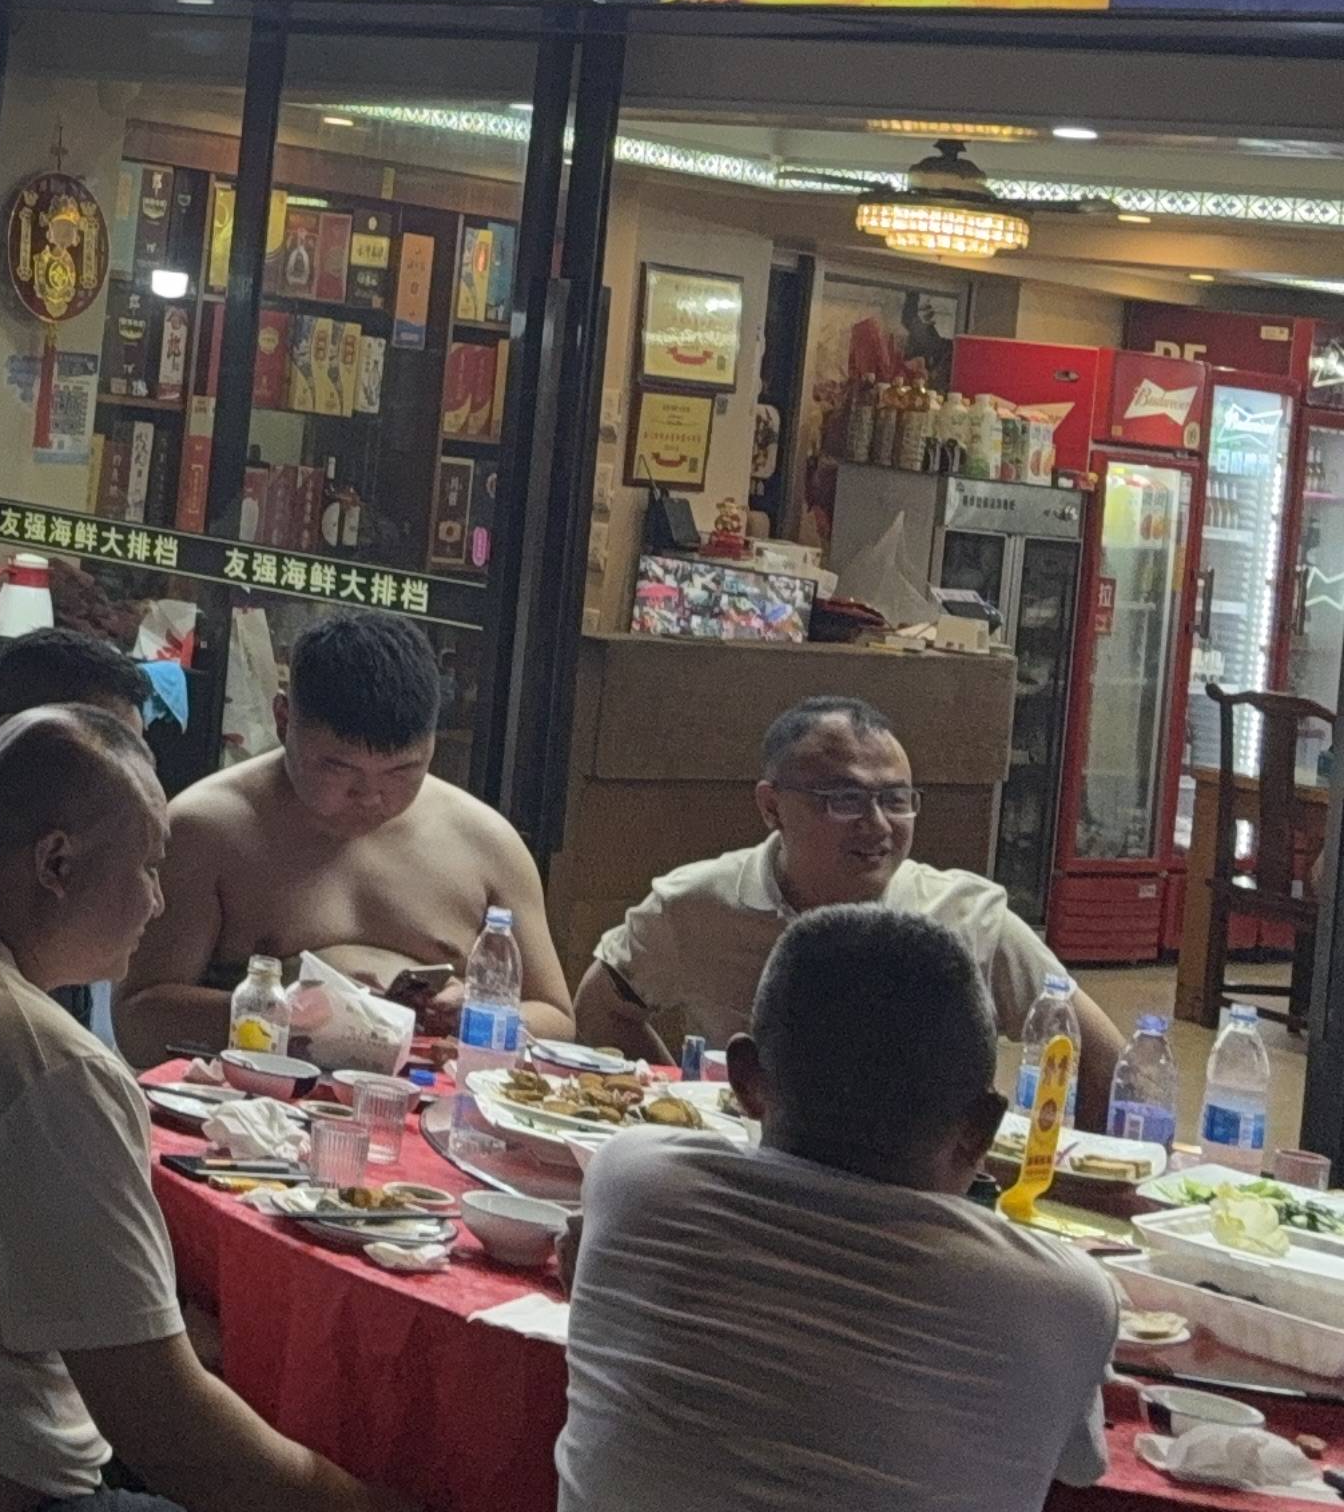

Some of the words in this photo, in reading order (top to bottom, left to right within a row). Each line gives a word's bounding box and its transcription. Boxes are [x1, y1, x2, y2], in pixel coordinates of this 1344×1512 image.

[0, 507, 179, 568] 友强海鲜大排档
[224, 548, 430, 613] 友强海鲜大排档
